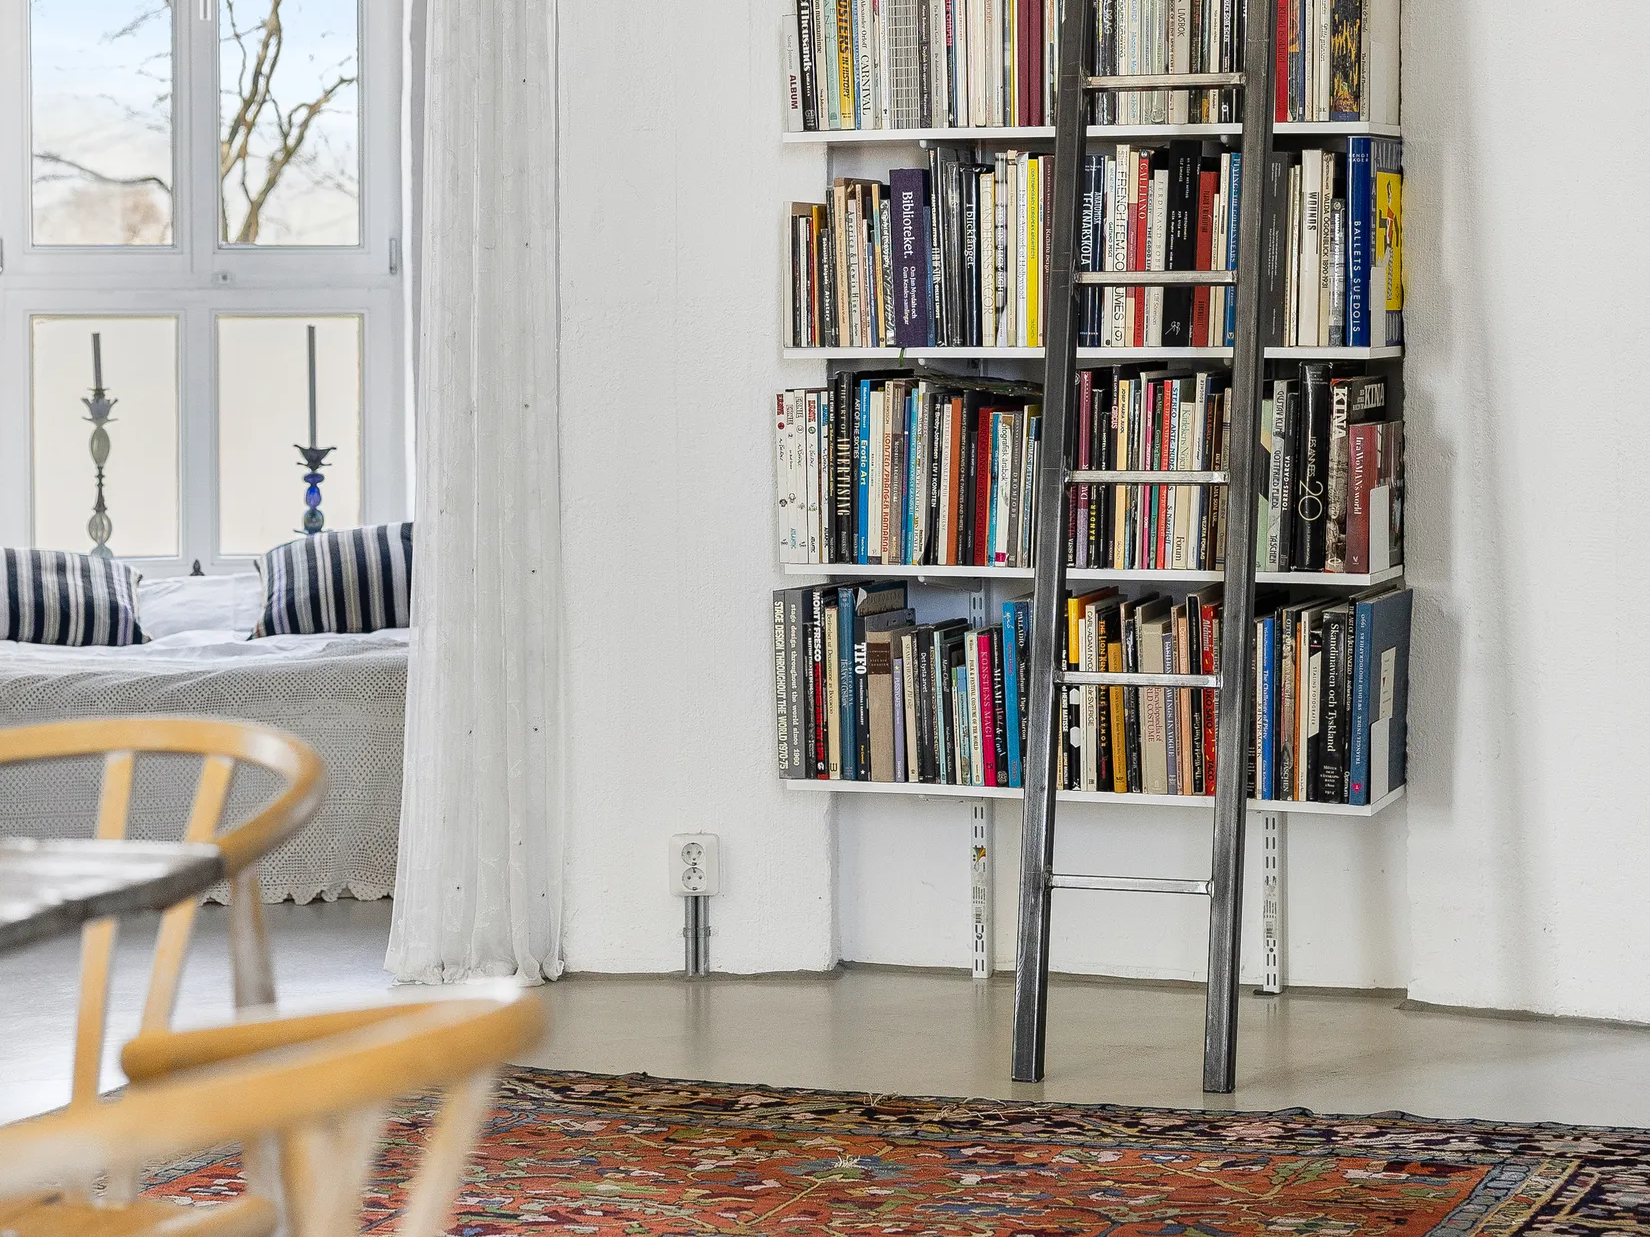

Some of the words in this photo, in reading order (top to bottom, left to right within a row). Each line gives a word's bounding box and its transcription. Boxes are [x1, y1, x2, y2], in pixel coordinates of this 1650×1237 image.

[801, 8, 811, 71] Thousands
[815, 11, 823, 53] mannaminne
[1177, 8, 1185, 37] LIVSBOK
[842, 56, 848, 66] IN
[789, 75, 798, 110] ALBUM
[841, 67, 850, 98] HISTORY
[861, 55, 870, 116] CARNIVAL
[1139, 163, 1148, 219] GALLIANO
[902, 191, 914, 259] Biblioteket.
[1308, 192, 1317, 231] WOUNDS
[964, 211, 976, 269] blickfånget.
[1323, 217, 1331, 257] ÖGONBLICK
[1353, 221, 1361, 272] BALLETS
[911, 266, 916, 276] Om
[841, 423, 846, 435] OF
[1333, 387, 1347, 440] KINA
[883, 433, 891, 467] KONSTEN
[837, 436, 850, 516] ADVERTISING
[883, 469, 891, 509] SPRÄNGER
[774, 601, 784, 623] STAGE
[775, 625, 784, 650] DESIGN
[1329, 623, 1339, 687] Skandinavien
[776, 652, 786, 699] THROUGHOUT
[854, 642, 866, 674] TIFO
[981, 651, 989, 707] KONSTENS
[778, 700, 787, 714] THE
[778, 715, 787, 741] WORLD
[1326, 710, 1337, 752] Tyskland
[779, 742, 788, 769] 1970-75
